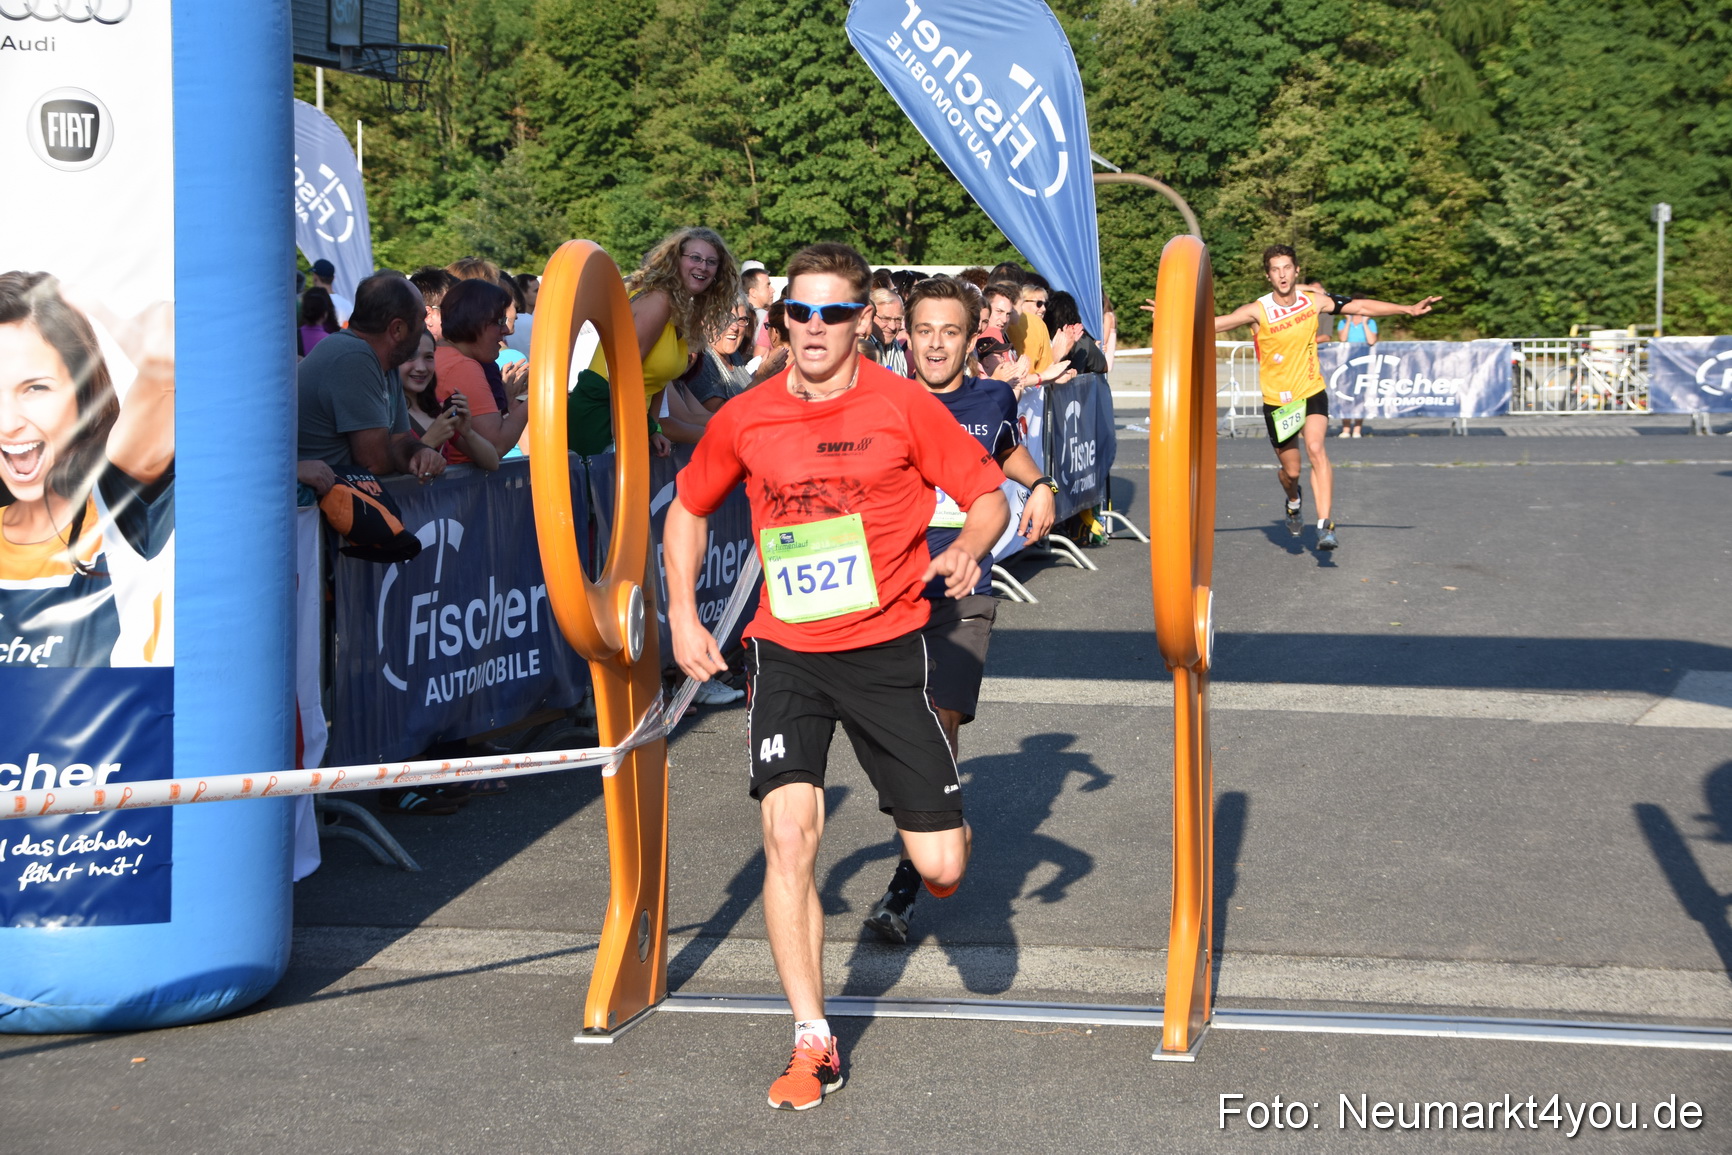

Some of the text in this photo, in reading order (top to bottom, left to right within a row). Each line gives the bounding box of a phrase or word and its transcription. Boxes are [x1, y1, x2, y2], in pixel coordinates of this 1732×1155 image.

[0, 36, 56, 52] Audi
[47, 112, 95, 148] FIAT
[1270, 321, 1293, 334] MAX
[1354, 373, 1465, 395] Fischer
[1364, 396, 1456, 407] AUTOMOBILE
[1282, 412, 1301, 430] 878
[816, 442, 855, 453] swn
[777, 555, 857, 596] 1527
[407, 576, 546, 665] Fischer
[425, 648, 541, 706] AUTOMOBILE
[760, 734, 785, 763] 44
[12, 834, 55, 857] das
[18, 854, 144, 892] fährt mit!
